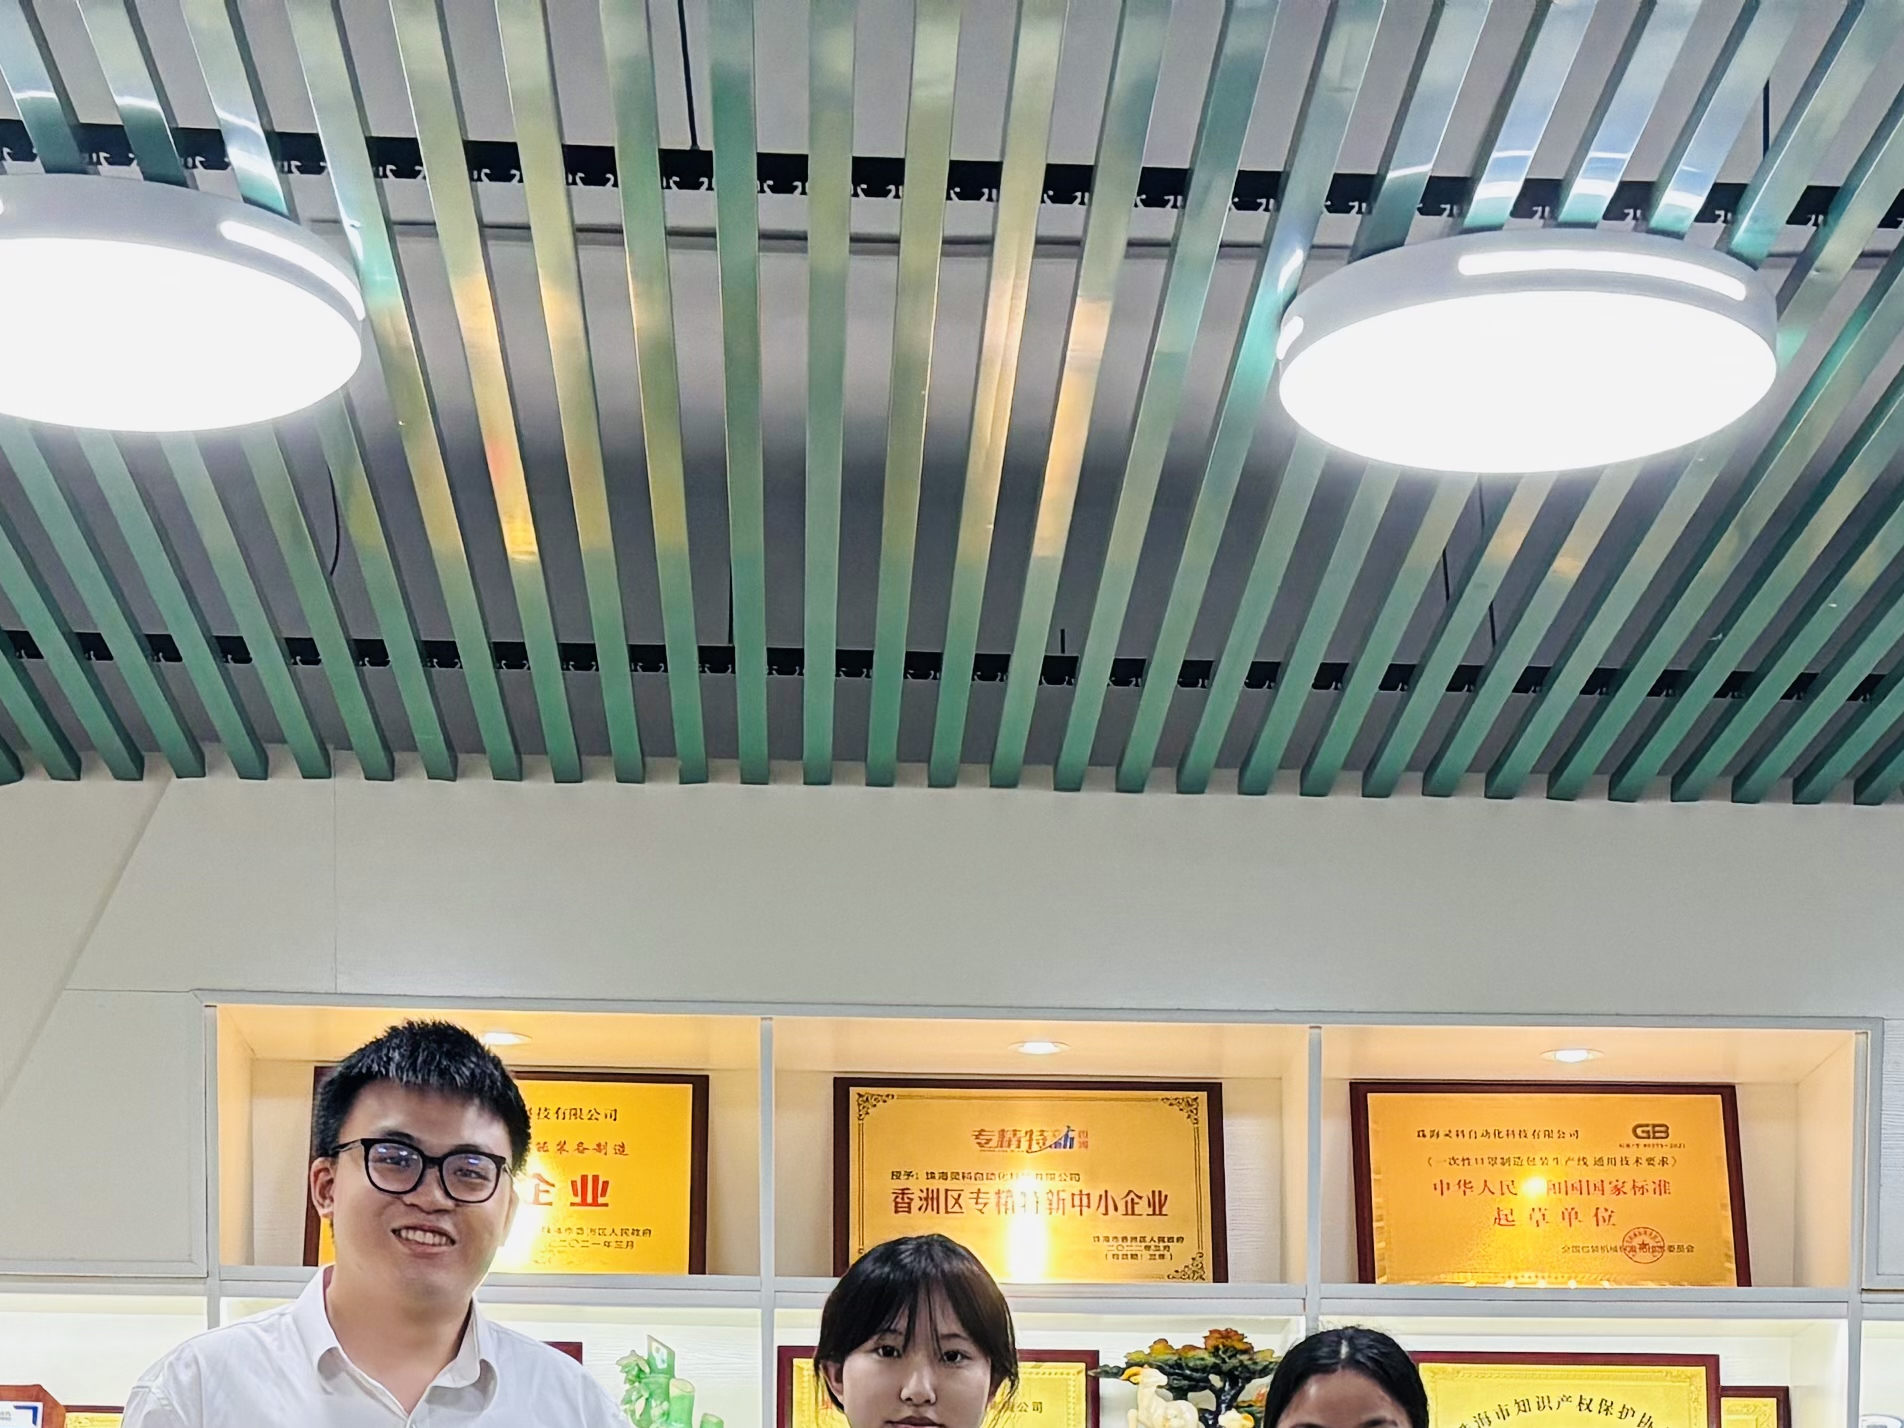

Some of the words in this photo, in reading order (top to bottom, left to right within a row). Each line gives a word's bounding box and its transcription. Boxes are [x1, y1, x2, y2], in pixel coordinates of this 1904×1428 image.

[1632, 1123, 1670, 1140] GB
[1433, 1179, 1672, 1196] 中华人民和国国家标准
[891, 1189, 1169, 1216] 香洲区专精特新中小企业
[1494, 1207, 1616, 1228] 起草单位
